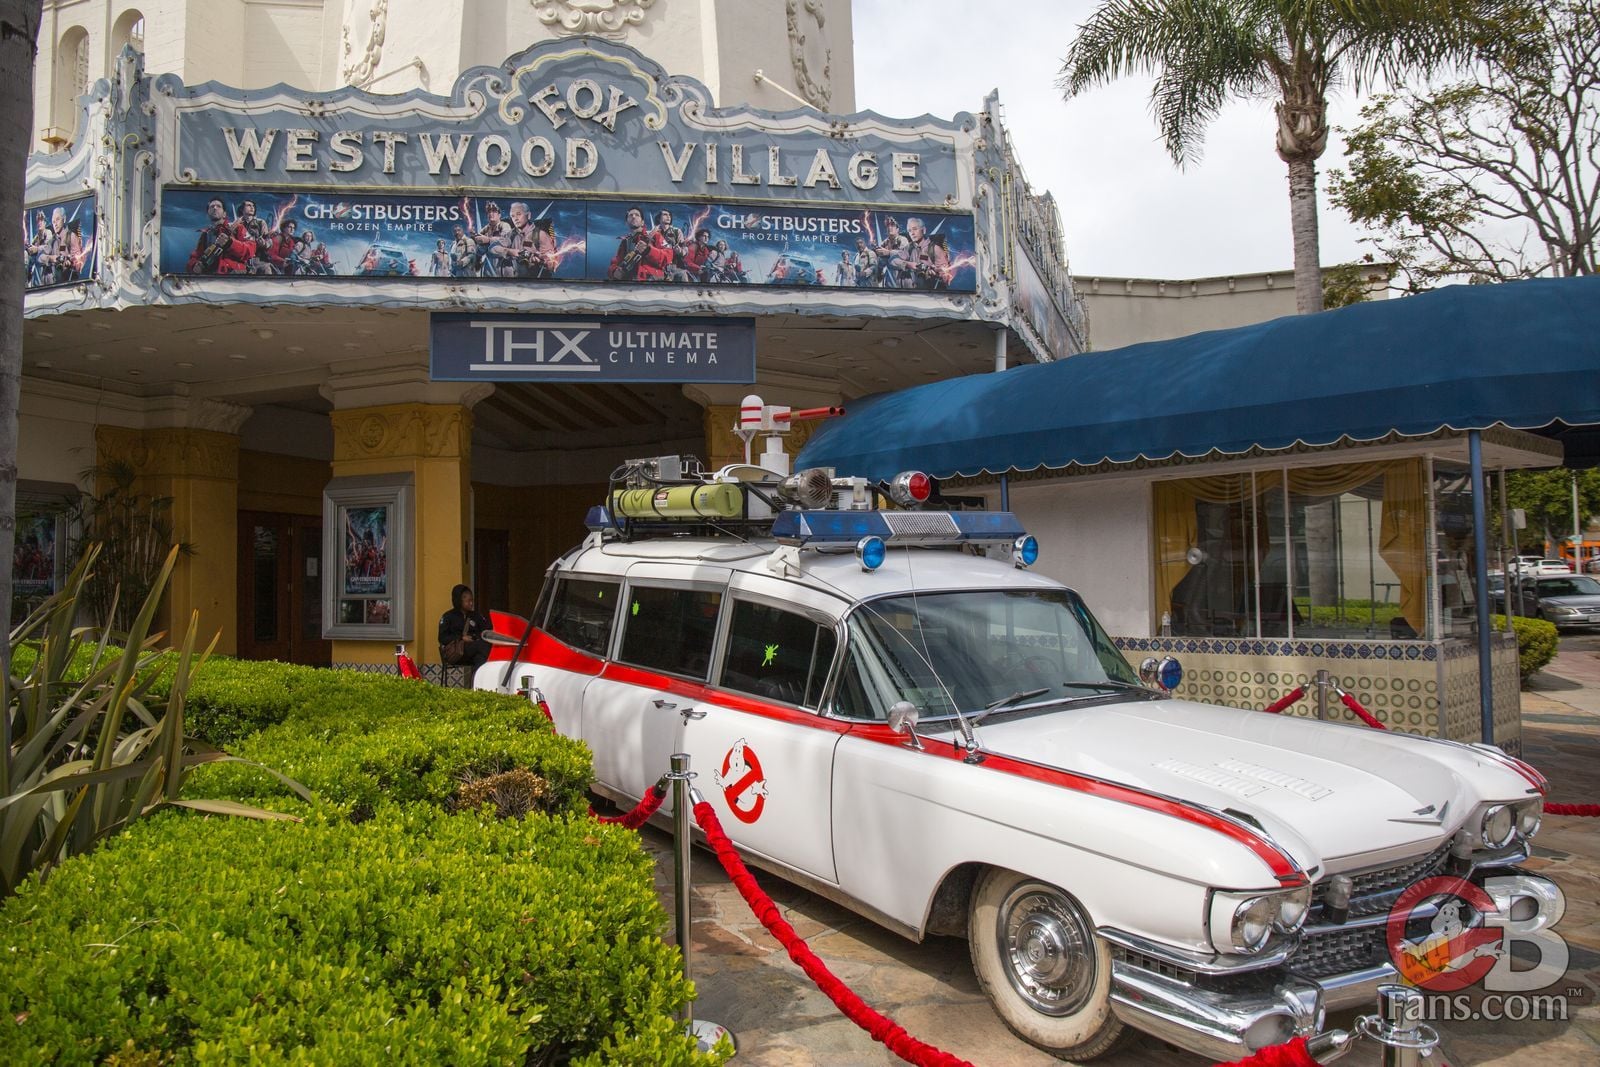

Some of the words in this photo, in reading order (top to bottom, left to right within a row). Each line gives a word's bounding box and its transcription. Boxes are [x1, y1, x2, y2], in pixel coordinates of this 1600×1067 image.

[528, 79, 639, 132] FOX
[220, 127, 599, 179] WESTWOOD
[657, 141, 921, 192] VILLAGE
[304, 203, 460, 220] GHOSTBUSTERS
[330, 222, 380, 231] FROZEN
[387, 223, 433, 232] EMPIRE
[717, 213, 861, 233] GHOSTBUSTERS
[742, 232, 788, 241] FROZEN
[795, 234, 837, 243] EMPIRE
[470, 321, 600, 363] THX
[609, 331, 718, 349] ULTIMATE
[609, 351, 718, 364] CINEMA
